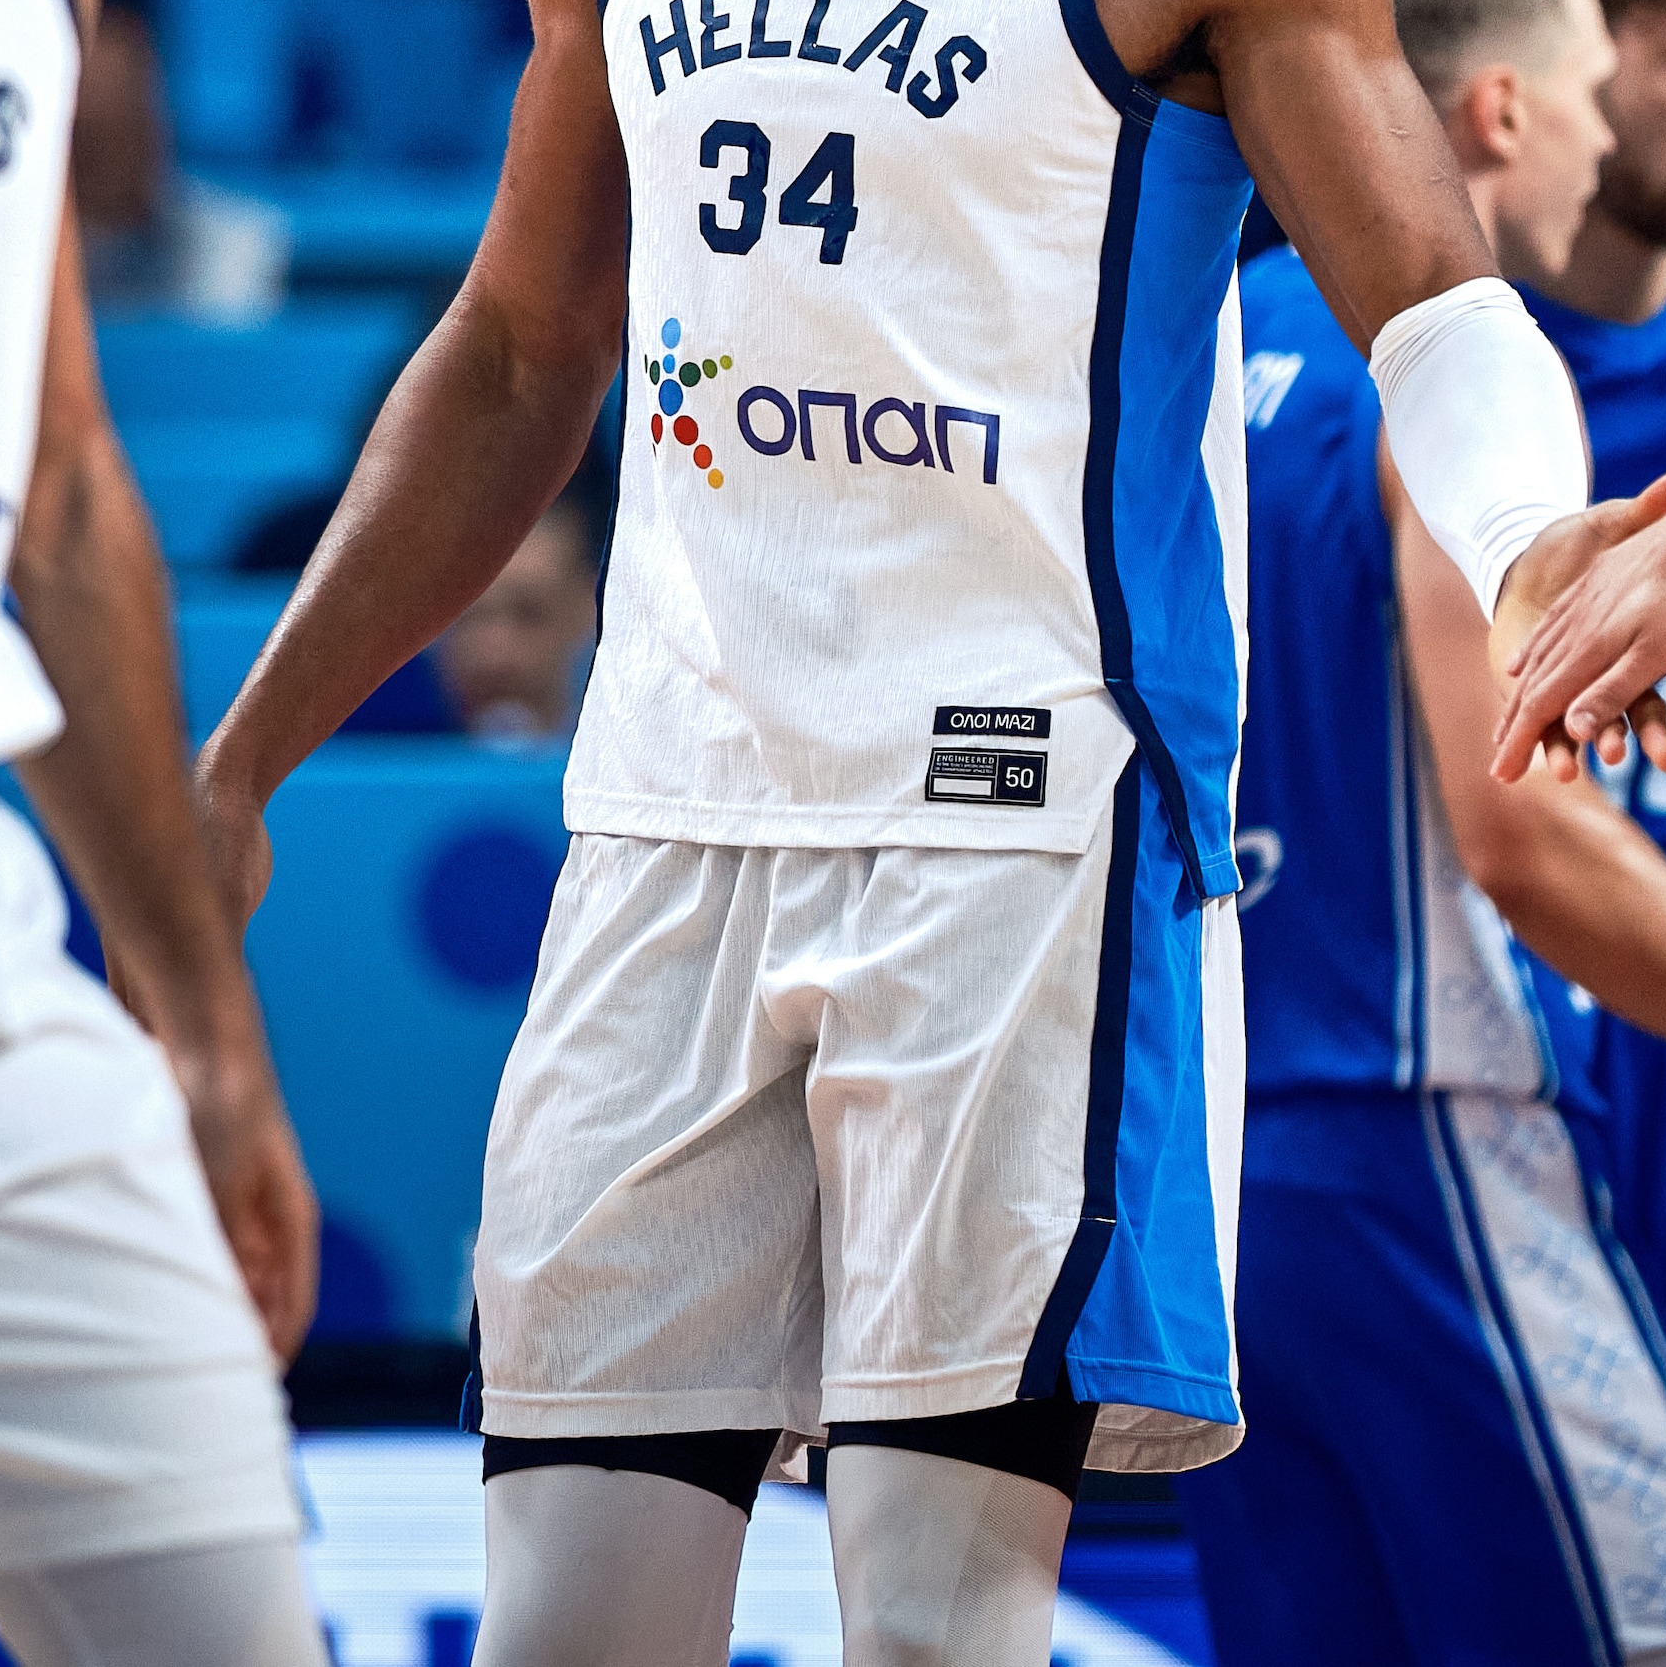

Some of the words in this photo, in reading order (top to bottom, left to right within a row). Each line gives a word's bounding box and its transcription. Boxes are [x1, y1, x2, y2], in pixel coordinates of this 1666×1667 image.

[699, 119, 859, 265] 34
[936, 755, 995, 765] ENGINEERED
[1005, 766, 1035, 789] 50
